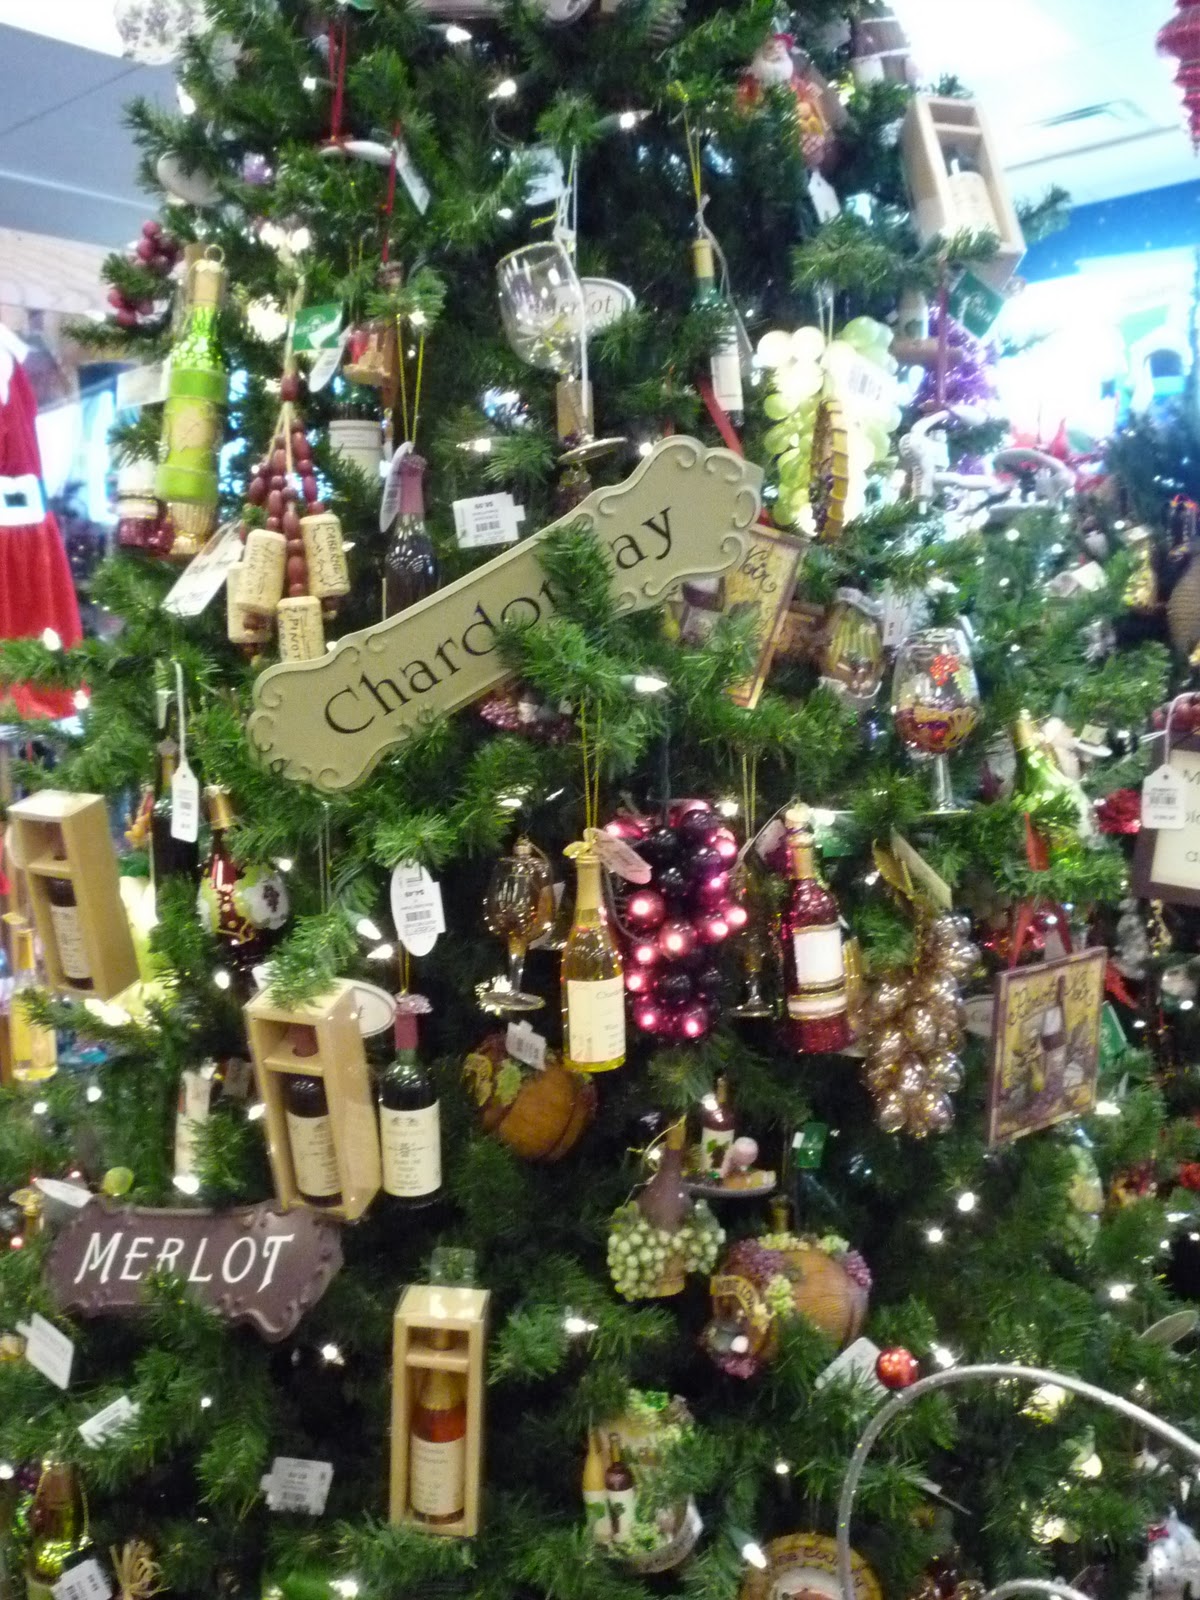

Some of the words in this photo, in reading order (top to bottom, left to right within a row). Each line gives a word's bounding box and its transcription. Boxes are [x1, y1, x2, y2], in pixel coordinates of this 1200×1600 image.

[289, 617, 299, 660] PINOT
[323, 506, 672, 735] Chardoay
[73, 1231, 296, 1294] MERLOT
